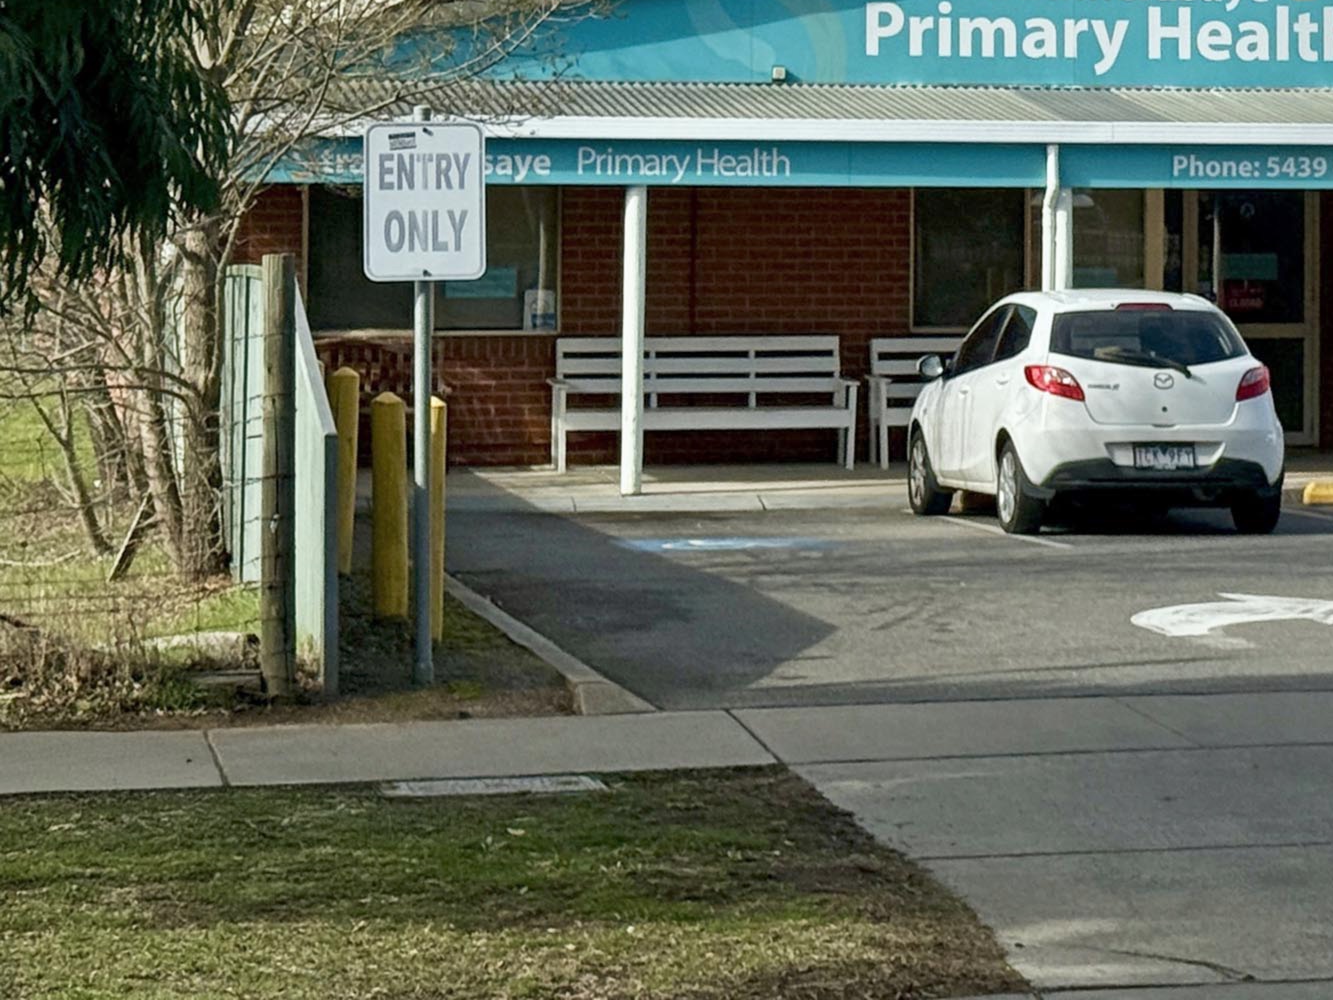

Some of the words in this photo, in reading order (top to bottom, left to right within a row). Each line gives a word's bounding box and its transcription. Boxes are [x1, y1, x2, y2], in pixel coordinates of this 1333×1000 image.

[864, 1, 1130, 75] Primary
[378, 152, 471, 191] ENTRY
[578, 146, 690, 184] Primary
[696, 147, 791, 178] Health
[1172, 154, 1261, 179] Phone:
[1266, 156, 1328, 179] 5439
[384, 209, 468, 253] ONLY
